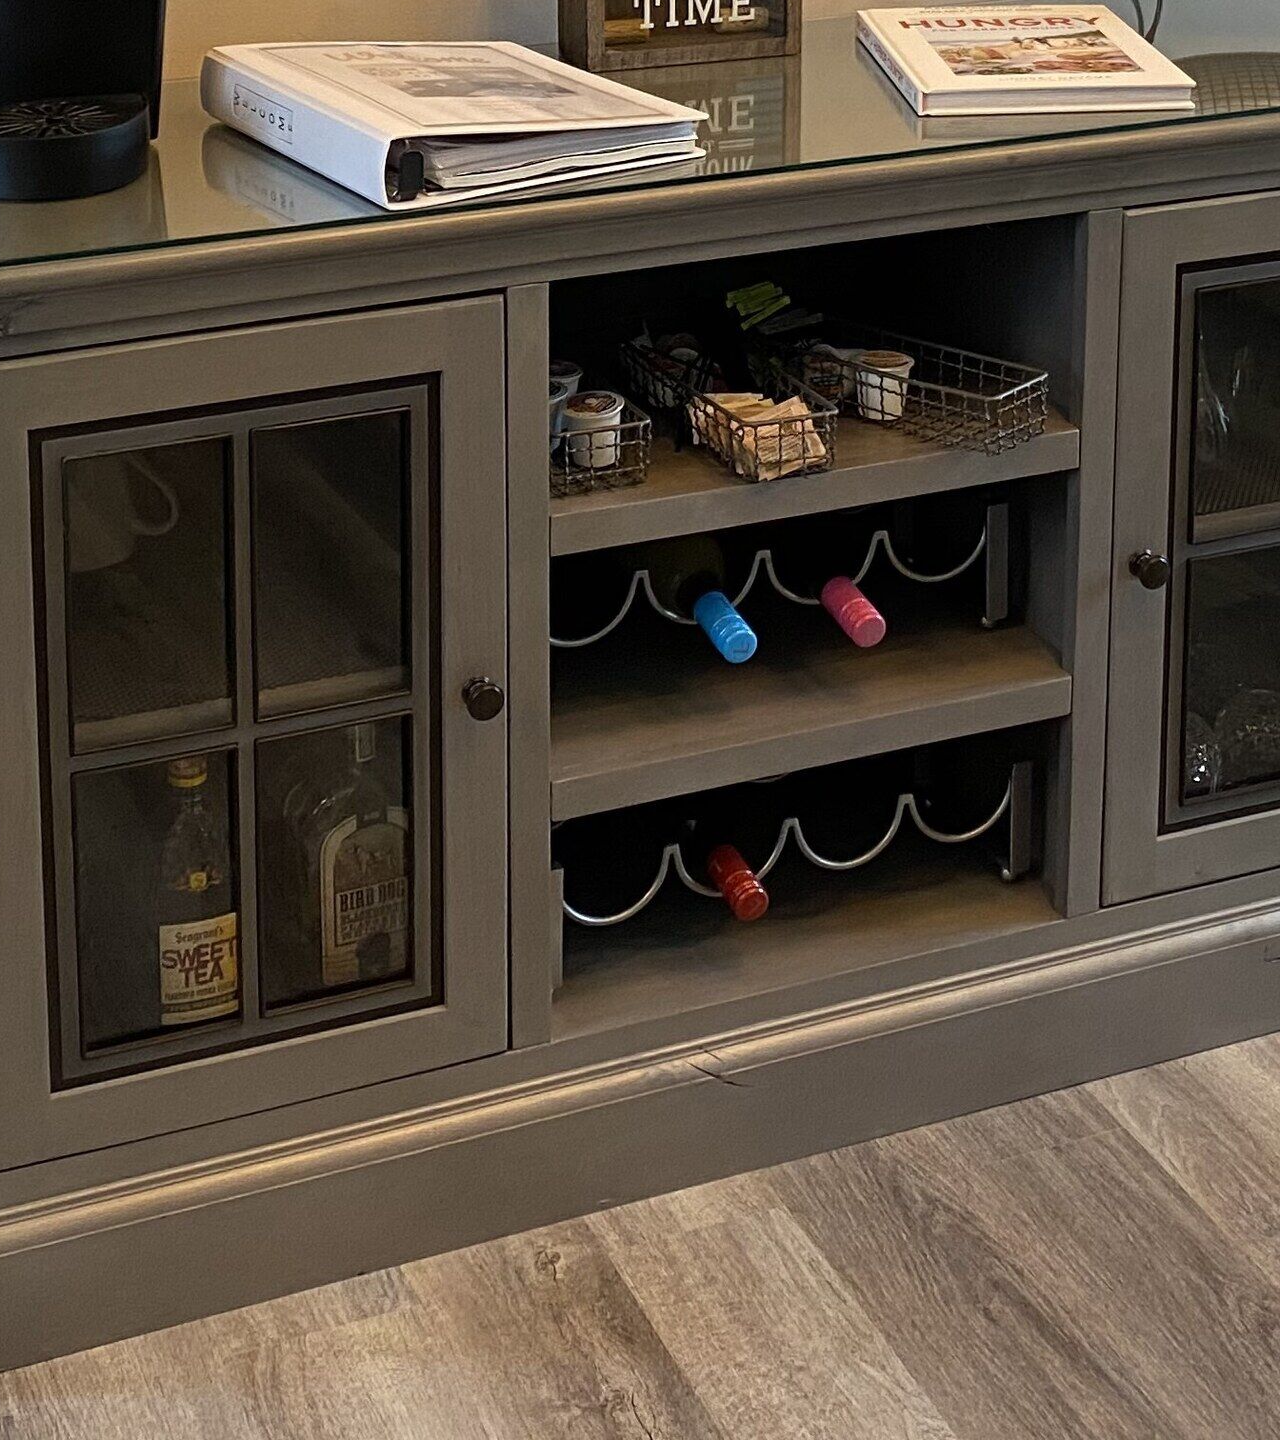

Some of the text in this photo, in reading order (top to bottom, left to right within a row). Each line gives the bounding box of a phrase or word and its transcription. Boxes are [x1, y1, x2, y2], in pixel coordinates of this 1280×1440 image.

[898, 16, 1101, 29] HUNGRY
[161, 937, 237, 969] SWEET
[178, 960, 224, 988] TEA
